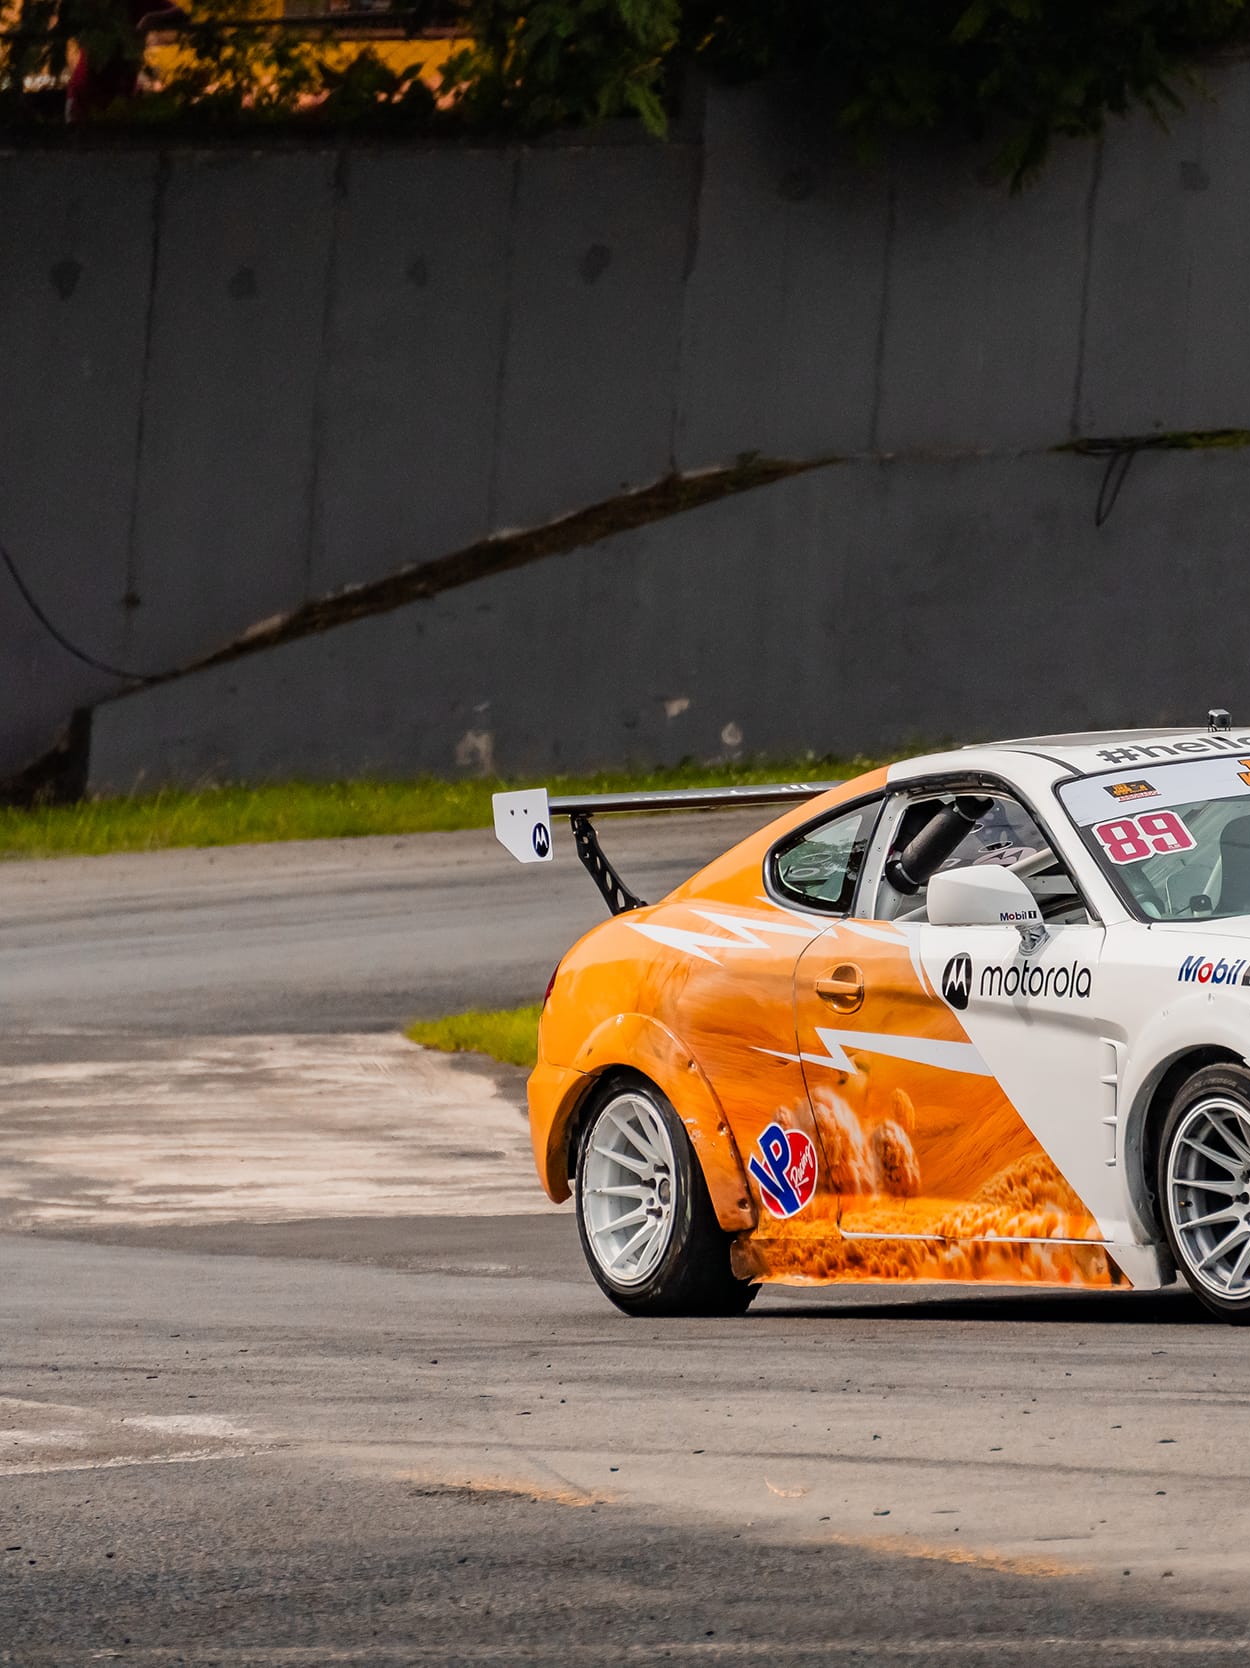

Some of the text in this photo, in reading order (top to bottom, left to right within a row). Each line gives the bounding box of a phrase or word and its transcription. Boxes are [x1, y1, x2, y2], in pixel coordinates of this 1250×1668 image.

[1096, 812, 1193, 862] 89
[1000, 911, 1027, 921] Mobil
[980, 960, 1091, 998] motorola
[1177, 955, 1242, 984] Mobil
[749, 1125, 800, 1214] VP
